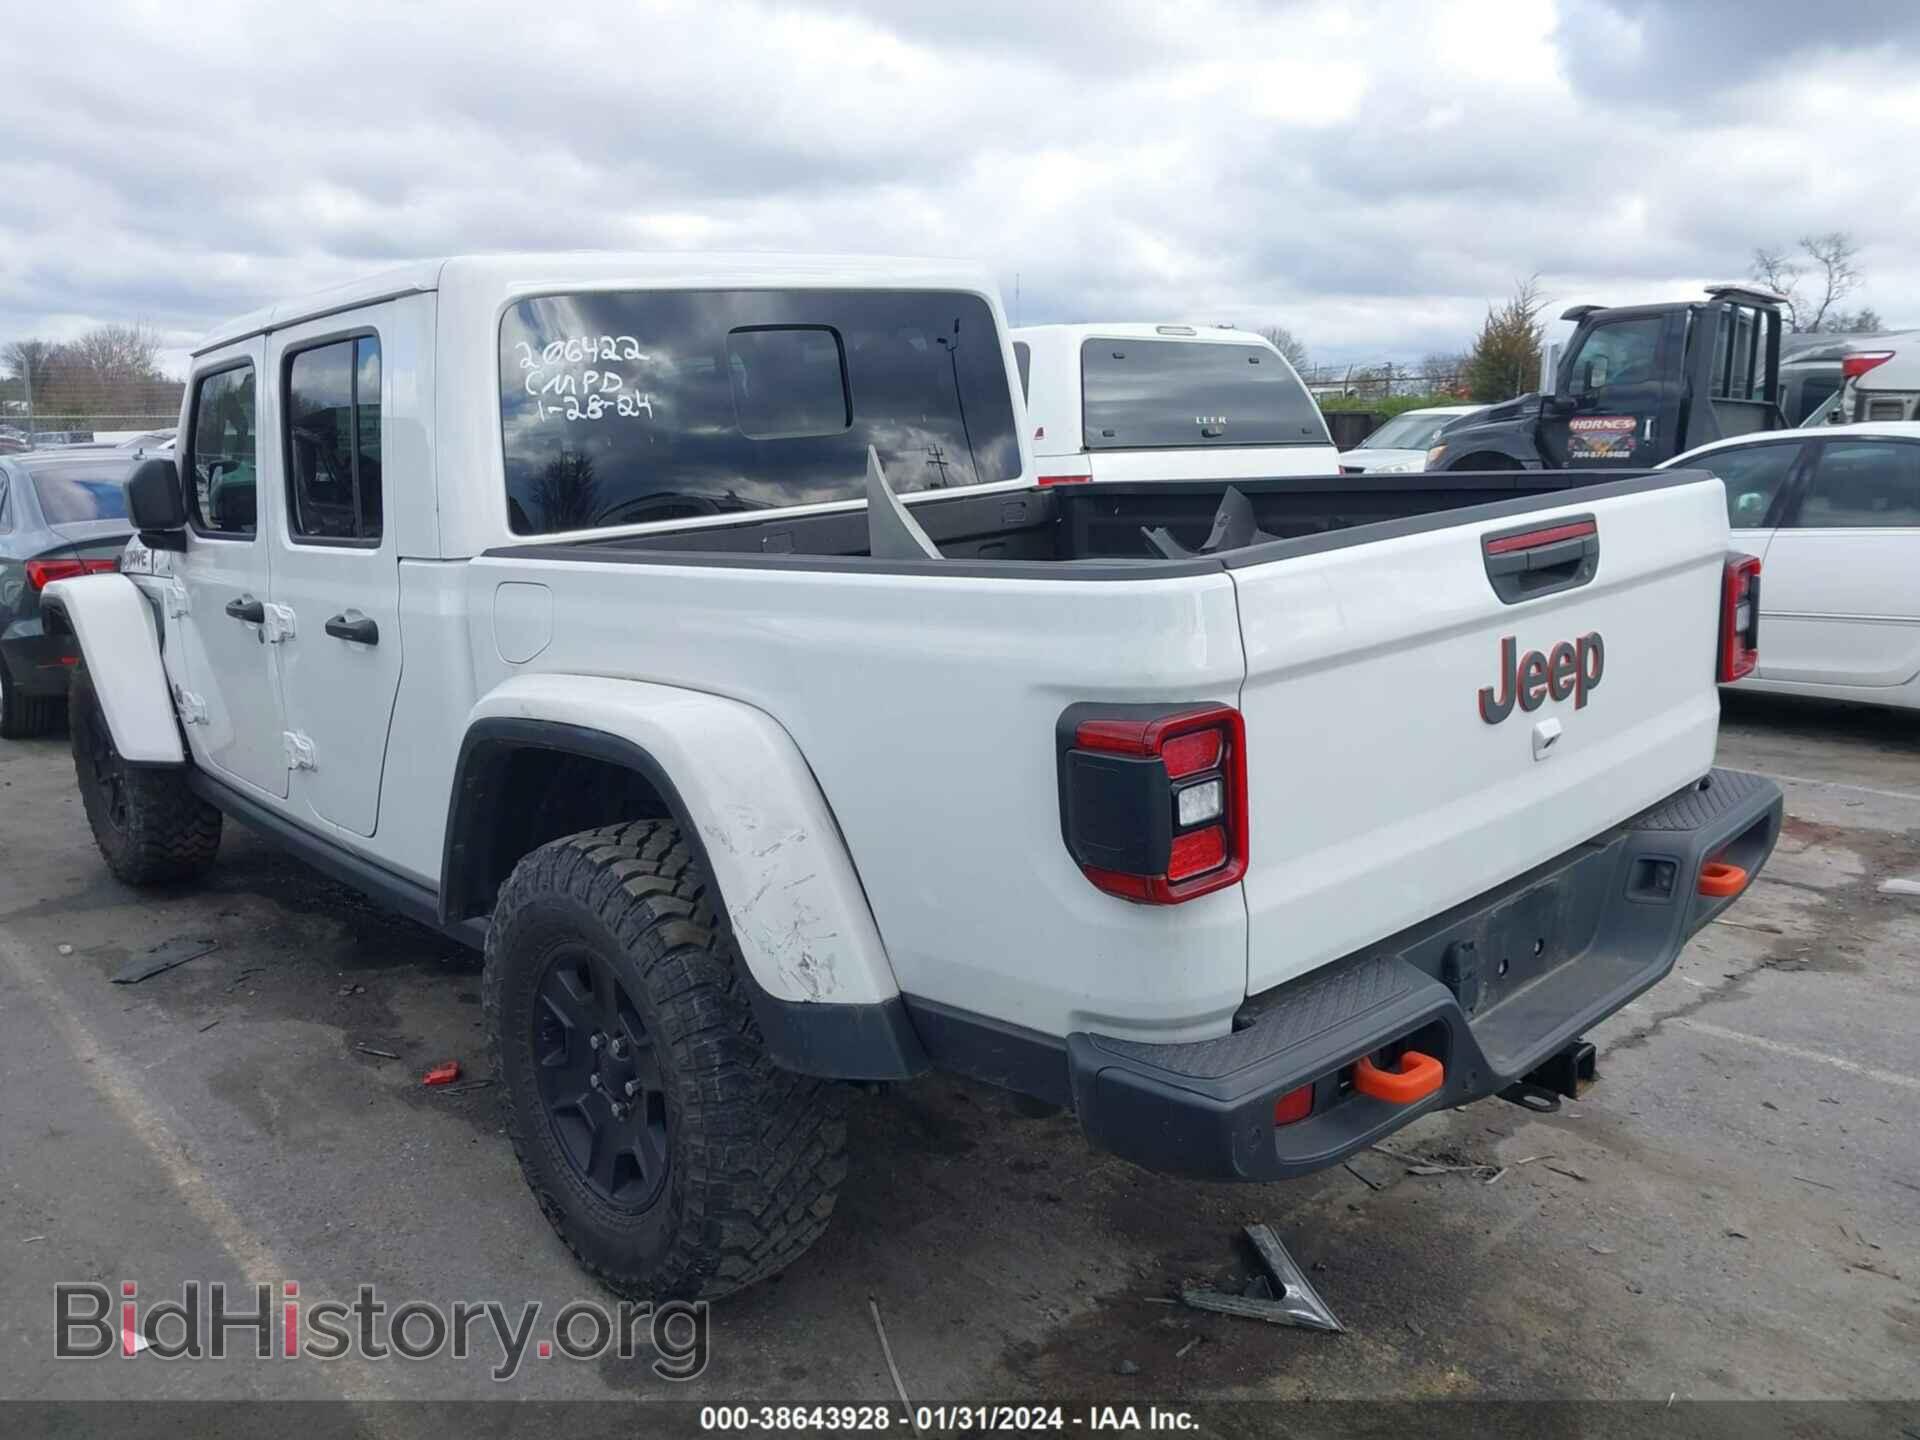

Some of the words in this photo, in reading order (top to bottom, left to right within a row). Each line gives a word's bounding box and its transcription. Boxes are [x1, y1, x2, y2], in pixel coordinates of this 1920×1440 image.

[515, 335, 650, 369] 206422
[525, 371, 623, 395] CMPD
[538, 389, 653, 422] 1-28-24
[1196, 416, 1227, 425] LEER
[1477, 631, 1605, 726] Jeep
